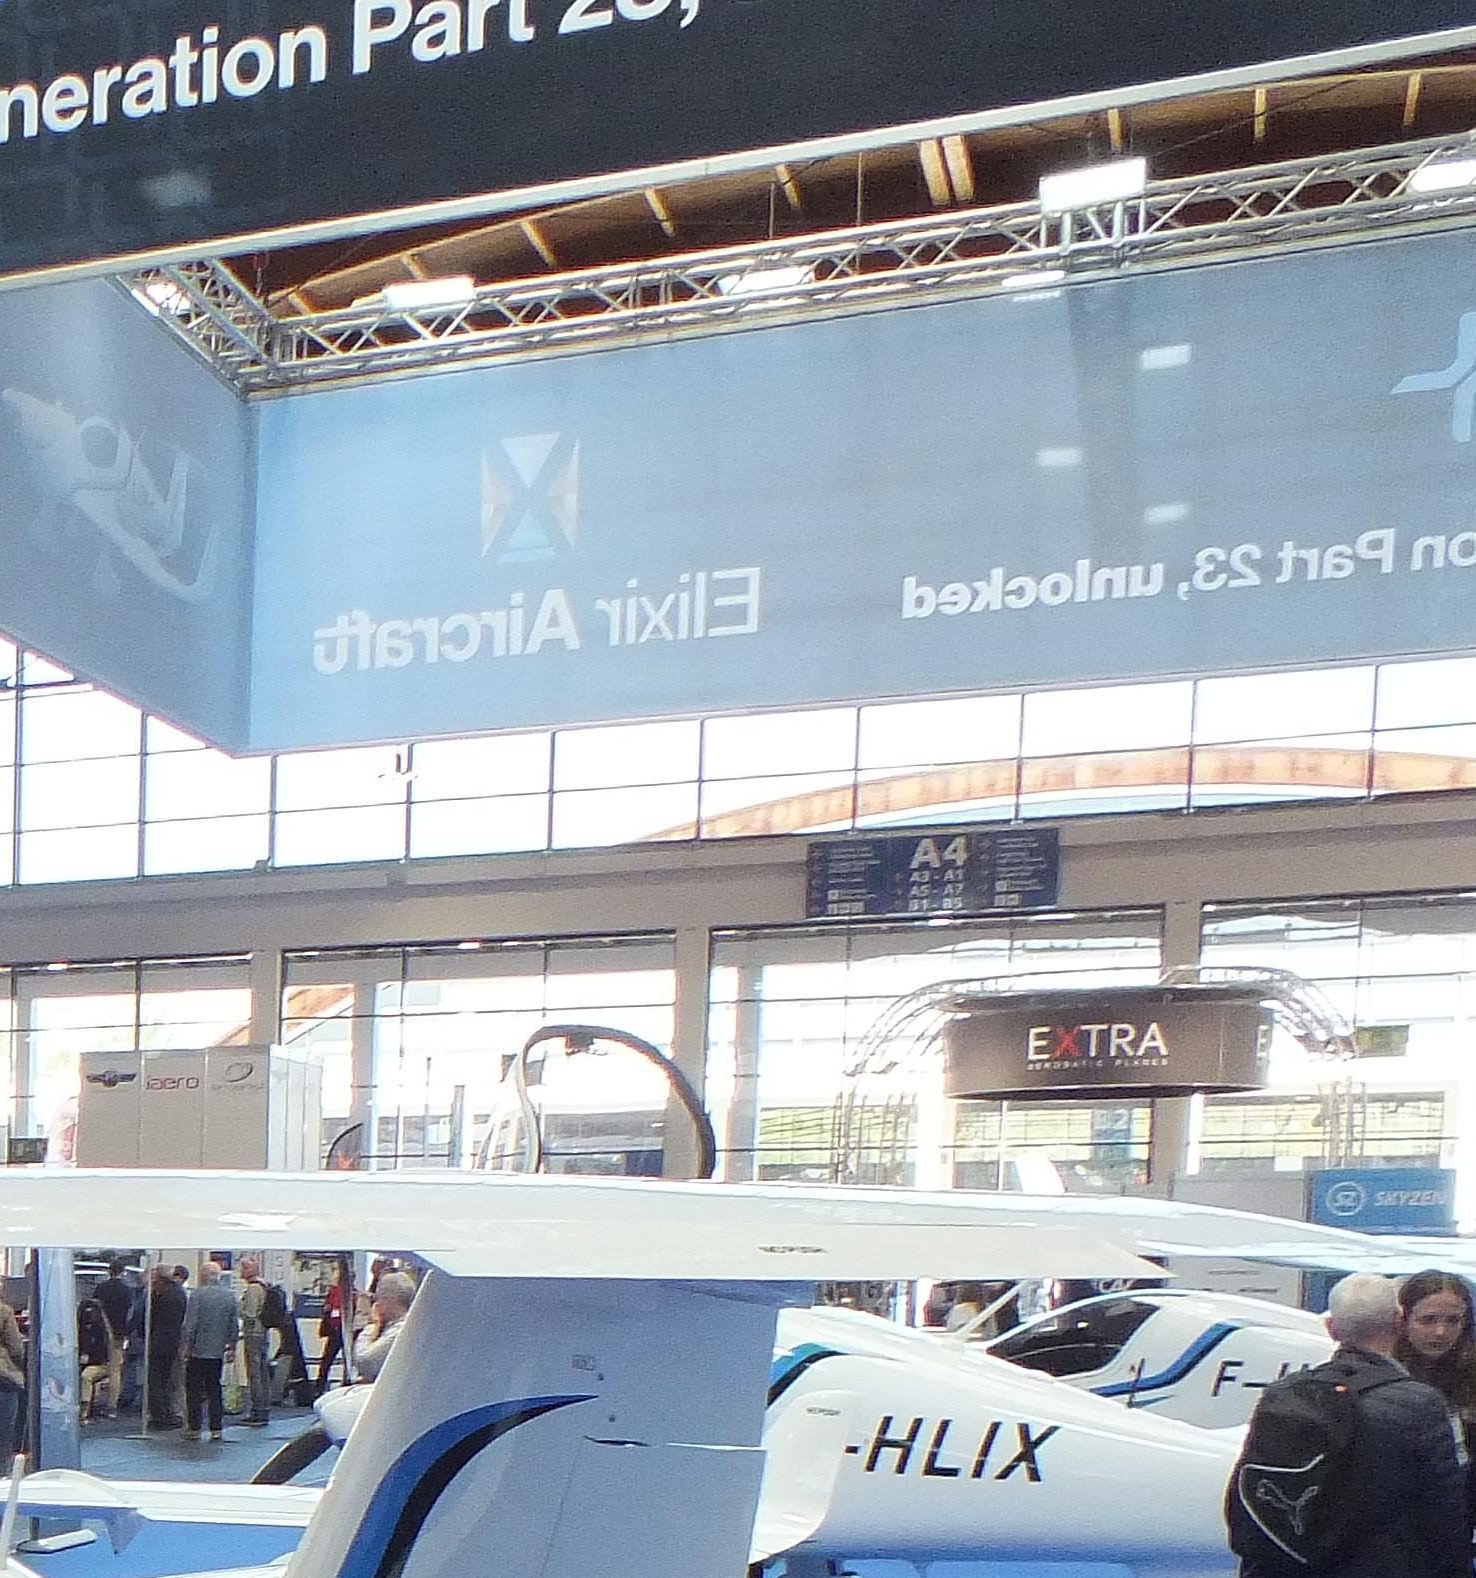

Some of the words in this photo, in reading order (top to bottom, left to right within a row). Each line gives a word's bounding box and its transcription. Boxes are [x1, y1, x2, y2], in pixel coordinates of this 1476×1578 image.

[351, 0, 535, 76] Part
[910, 836, 968, 869] A4
[911, 871, 930, 883] A3
[1027, 1022, 1169, 1061] EXTRA
